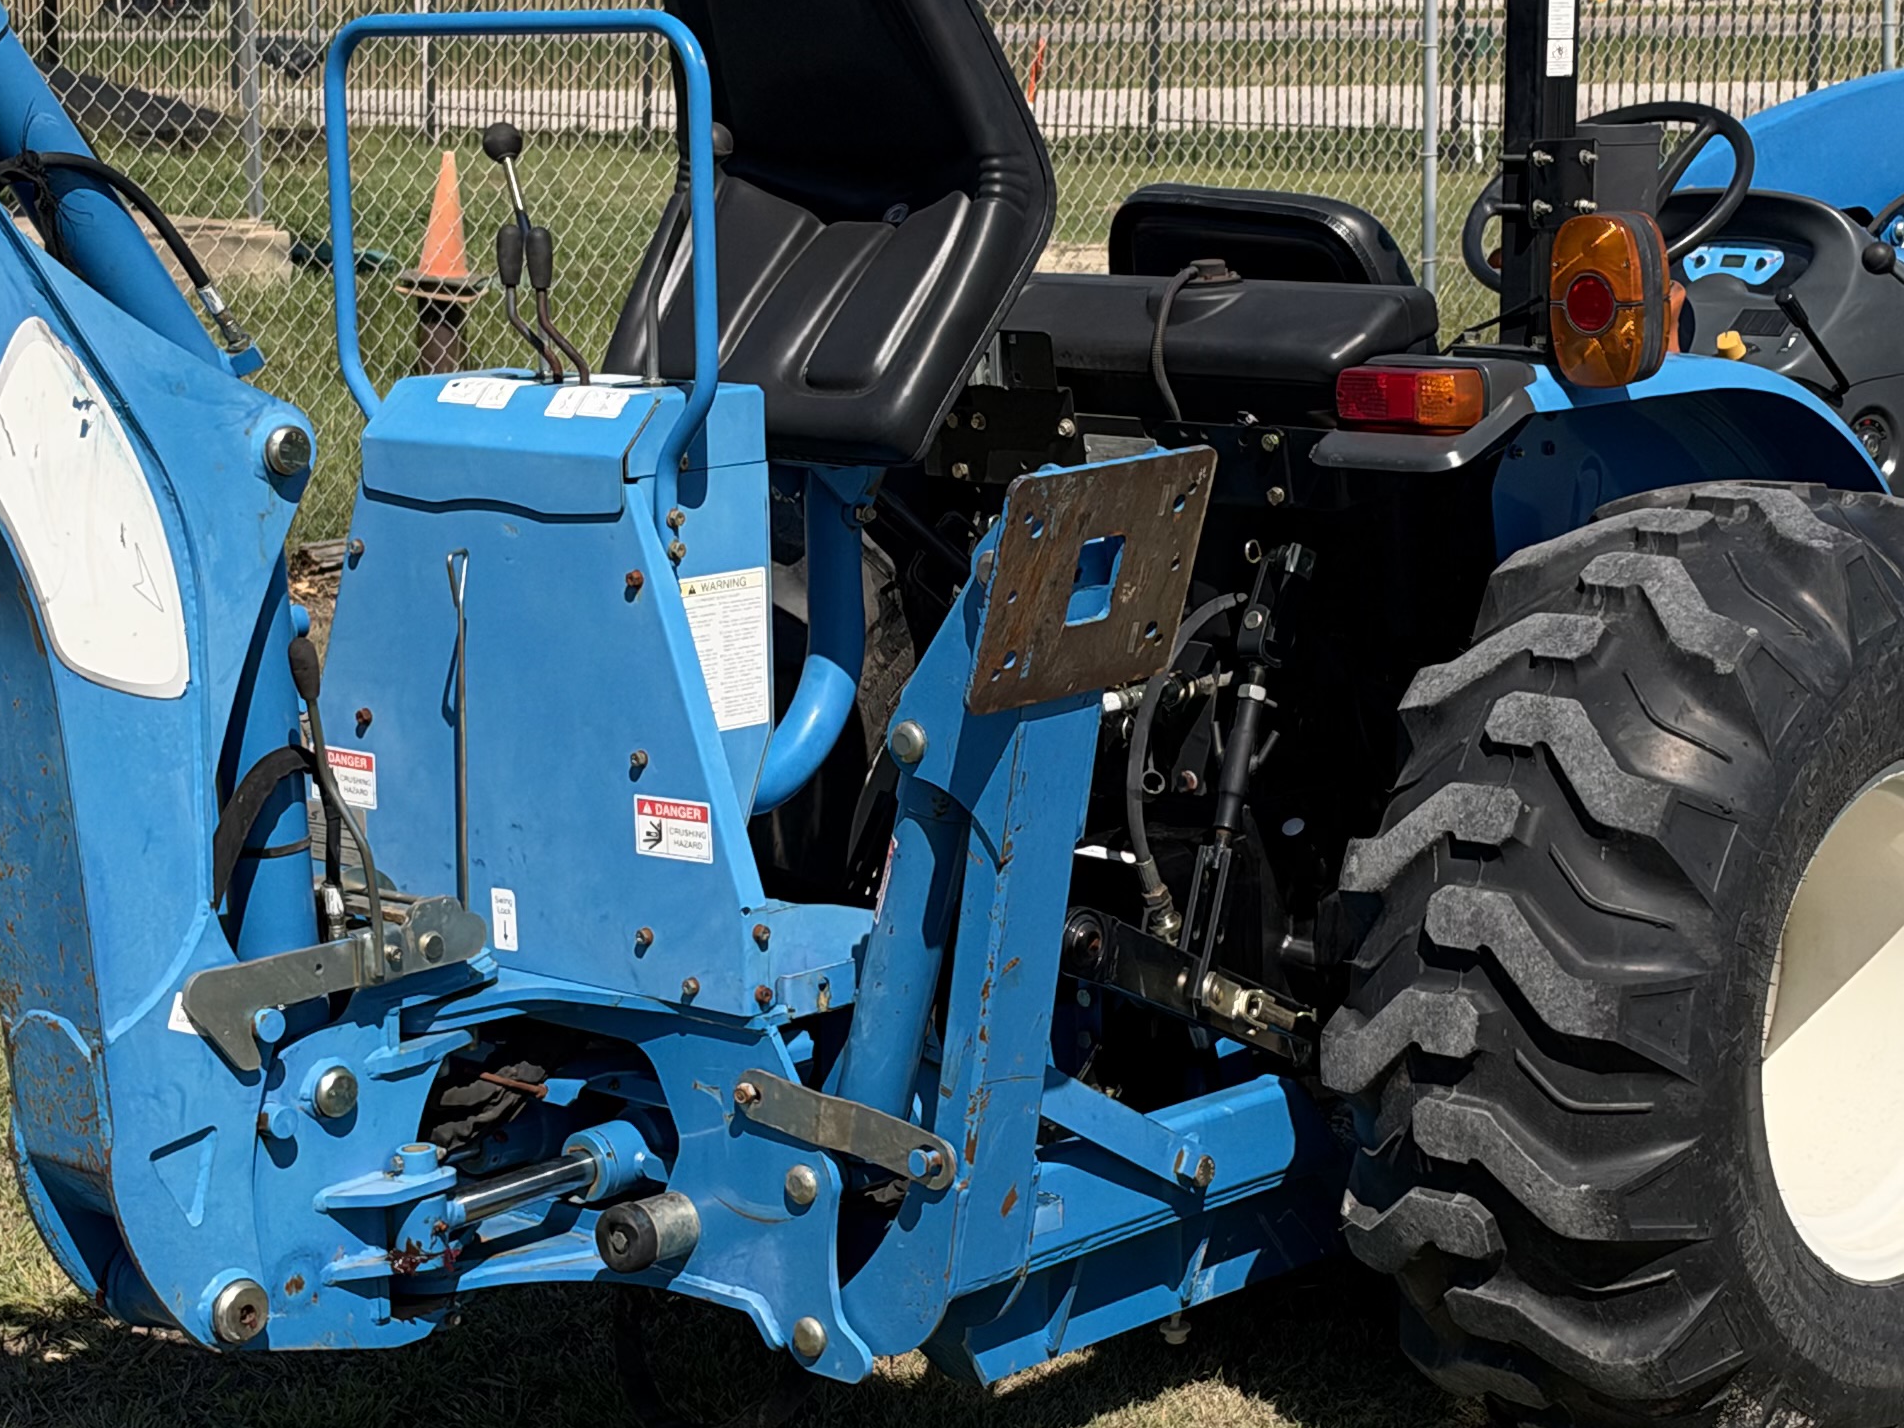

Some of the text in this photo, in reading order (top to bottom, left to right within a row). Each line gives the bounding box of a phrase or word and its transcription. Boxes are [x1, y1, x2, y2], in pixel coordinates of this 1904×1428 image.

[700, 575, 748, 593] WARNING
[327, 752, 368, 770] DANGER
[339, 773, 372, 788] CRUSHING
[343, 786, 369, 797] HAZARD
[654, 803, 702, 821] DANGER
[668, 827, 707, 840] CRUSHING
[673, 839, 703, 851] HAZARD
